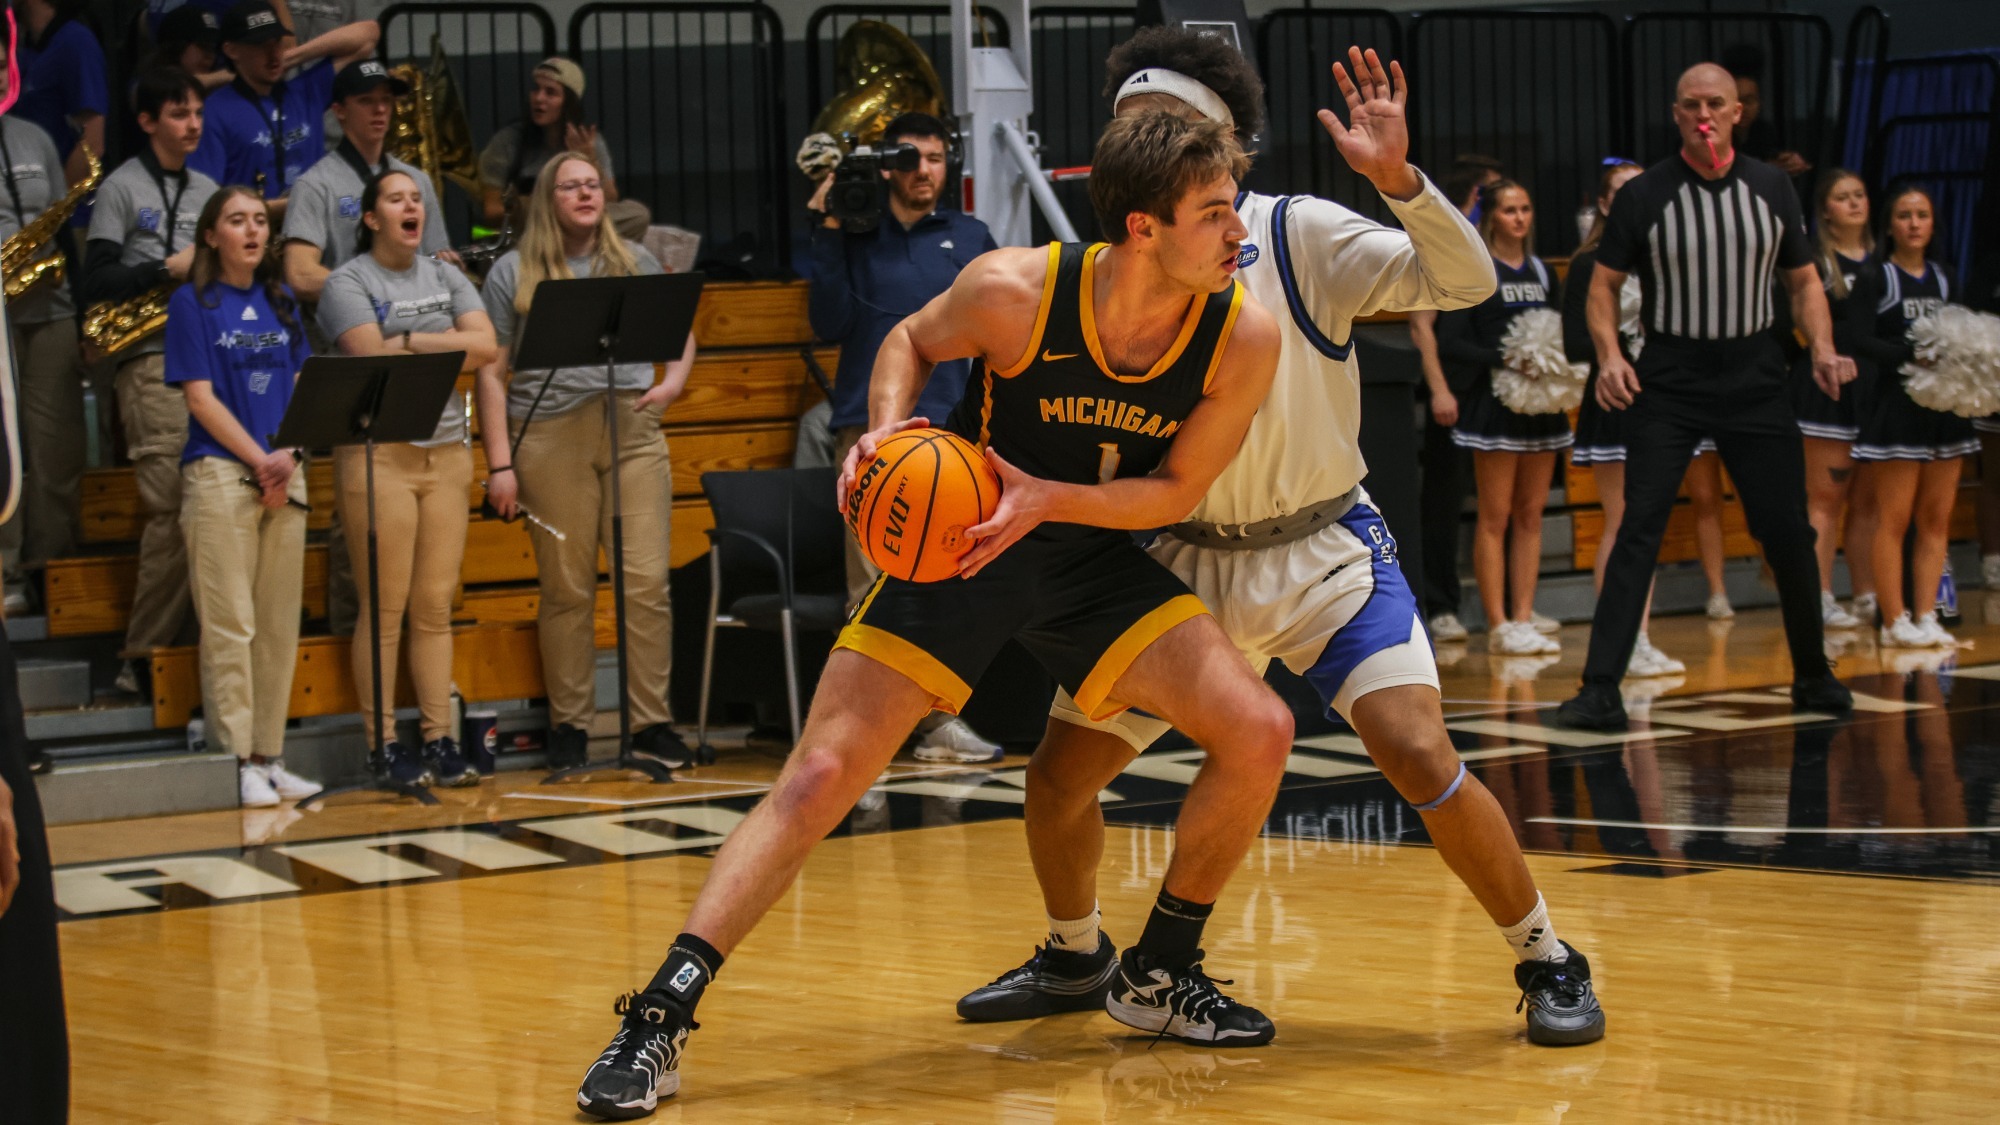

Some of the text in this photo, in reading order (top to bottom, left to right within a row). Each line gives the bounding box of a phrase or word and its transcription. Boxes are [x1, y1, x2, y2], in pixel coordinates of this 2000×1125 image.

[1501, 283, 1546, 303] GVSU
[1902, 297, 1939, 319] GVS
[1039, 397, 1183, 438] MICHIGAN
[1098, 442, 1121, 485] 1
[897, 474, 910, 496] NXT
